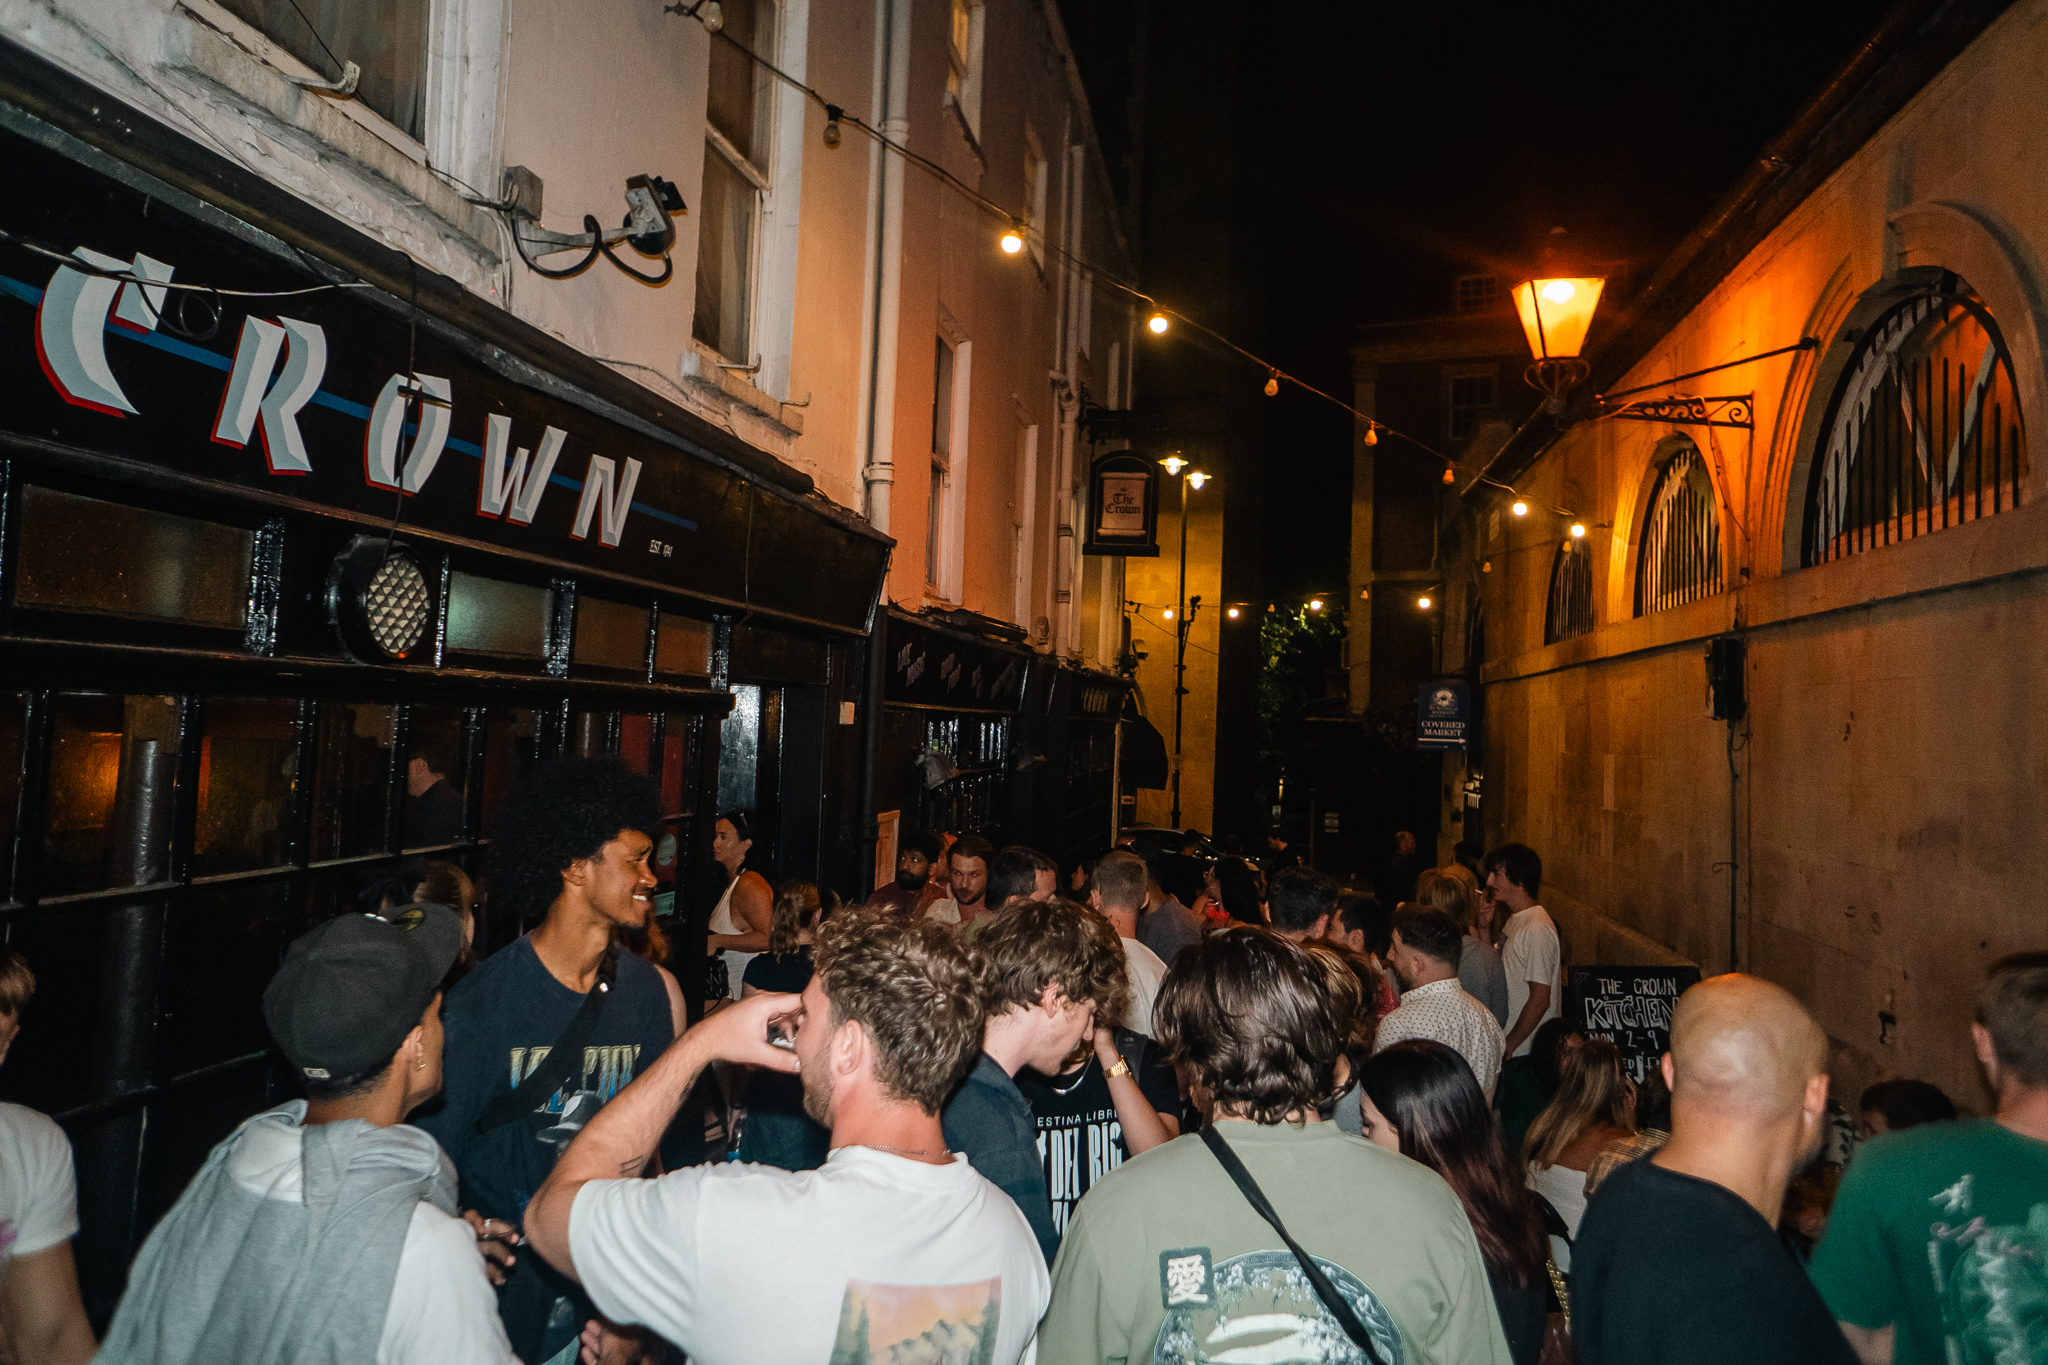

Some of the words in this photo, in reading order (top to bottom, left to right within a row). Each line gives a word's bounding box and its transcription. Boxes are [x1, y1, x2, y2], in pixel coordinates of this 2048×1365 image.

[35, 246, 643, 549] CROWN
[1113, 493, 1135, 504] The
[1105, 503, 1141, 514] Crown
[1421, 720, 1466, 729] COVERED
[1424, 728, 1463, 737] MARKET
[1597, 978, 1624, 995] THE
[1634, 977, 1677, 996] CROWN
[1037, 1114, 1082, 1127] ESTINA
[1167, 1254, 1208, 1304] 愛
